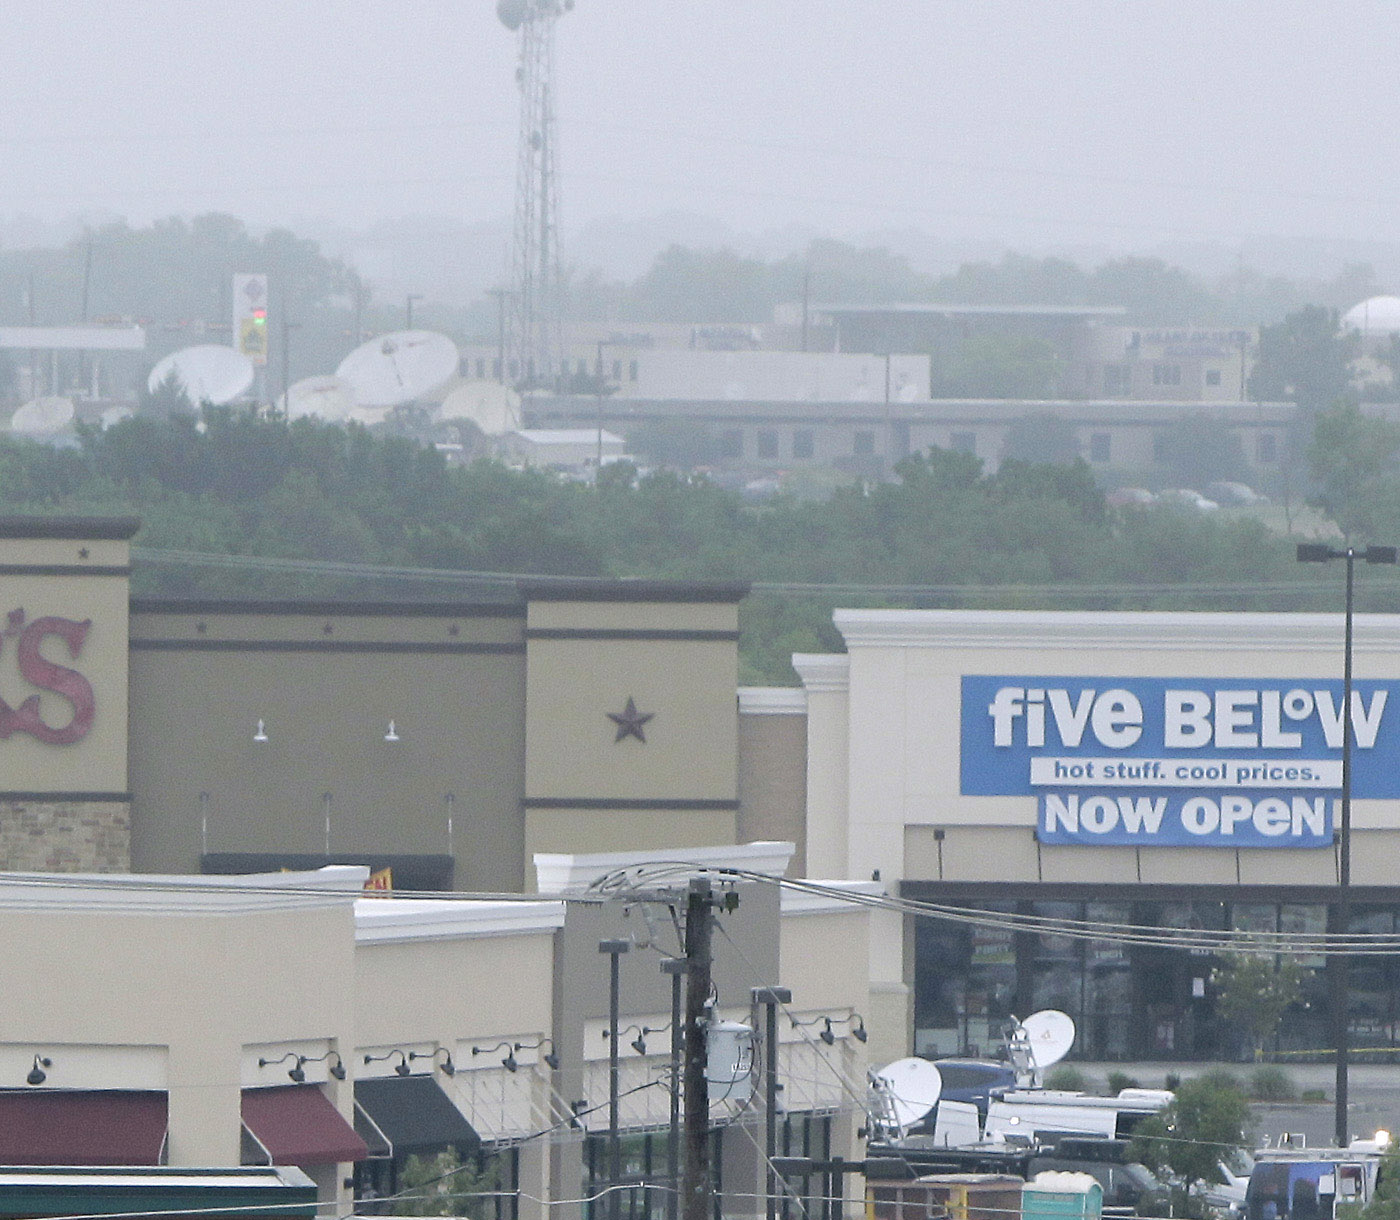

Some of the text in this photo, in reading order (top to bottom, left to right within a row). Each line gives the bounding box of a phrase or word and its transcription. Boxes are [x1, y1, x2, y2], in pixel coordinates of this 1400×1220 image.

[989, 687, 1144, 748] five
[1054, 761, 1320, 785] hot stuff. cool prices.
[1044, 794, 1168, 833] NOW
